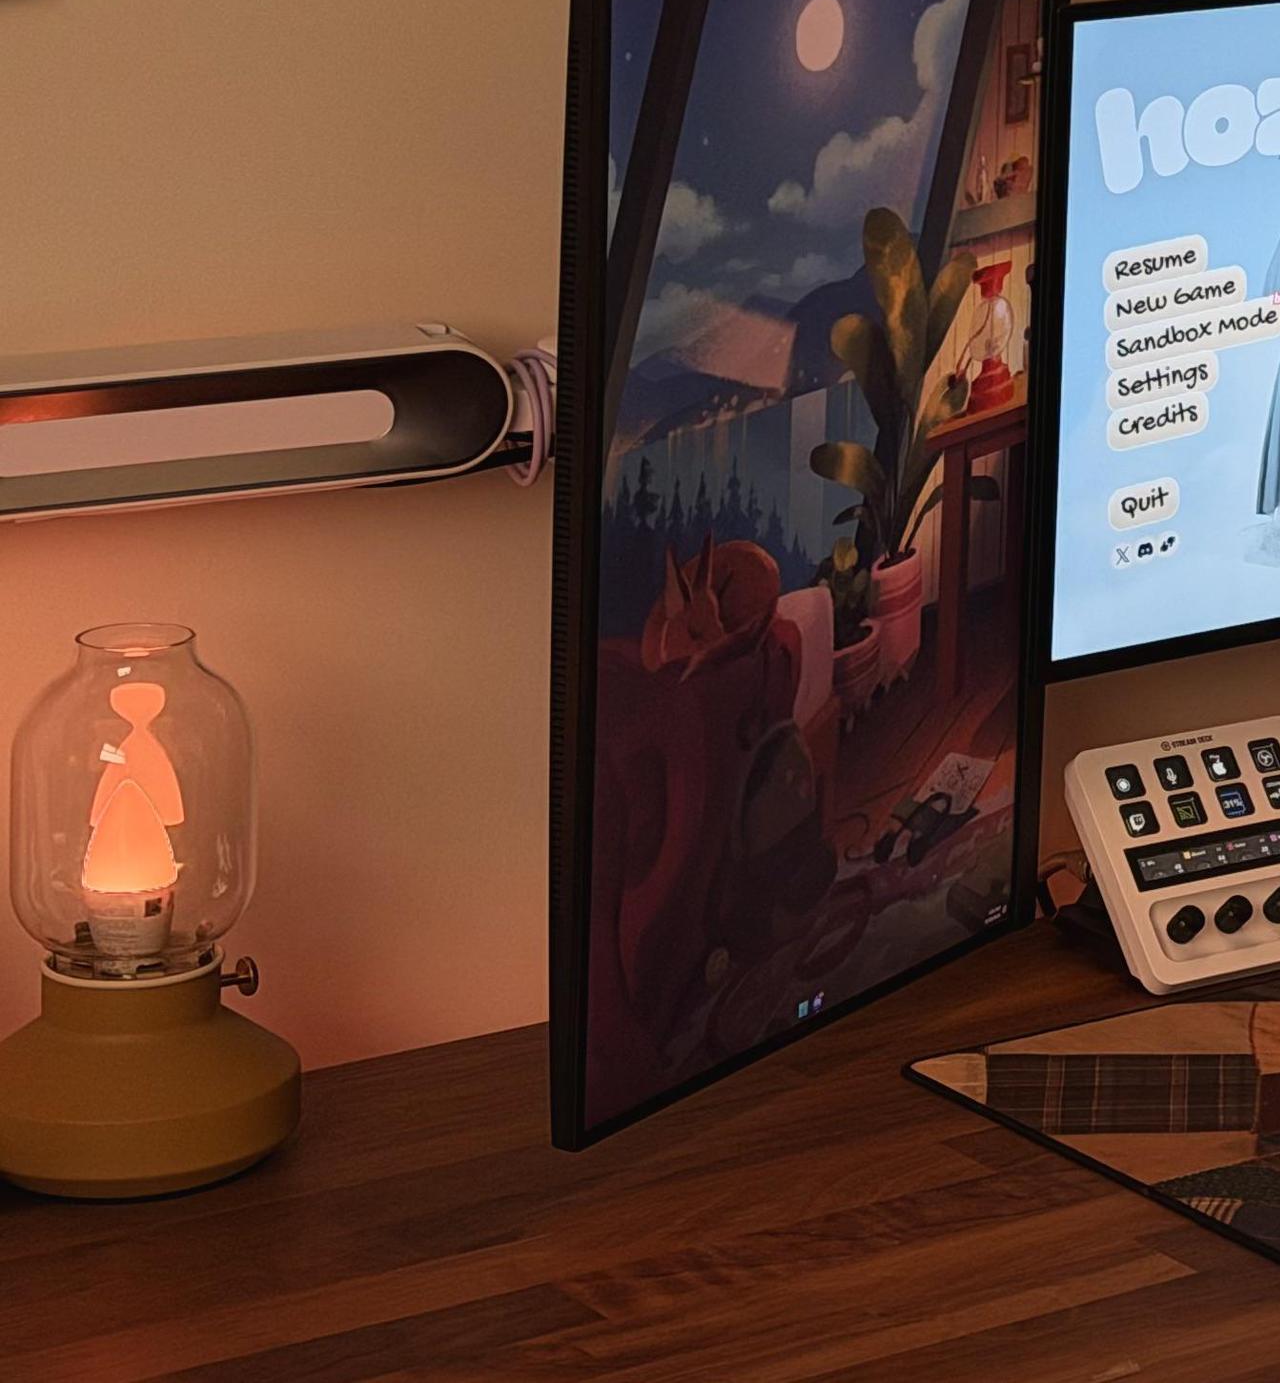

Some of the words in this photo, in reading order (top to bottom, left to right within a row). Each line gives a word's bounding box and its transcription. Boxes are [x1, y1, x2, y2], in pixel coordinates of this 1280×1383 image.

[1115, 248, 1196, 280] Resume
[1116, 293, 1168, 319] New
[1174, 278, 1236, 303] Game
[1116, 320, 1213, 357] Sandbox
[1220, 306, 1278, 335] Mode
[1118, 361, 1208, 397] Settings
[1119, 403, 1198, 436] Credits
[1122, 486, 1169, 517] Quit
[1198, 735, 1213, 744] DECK
